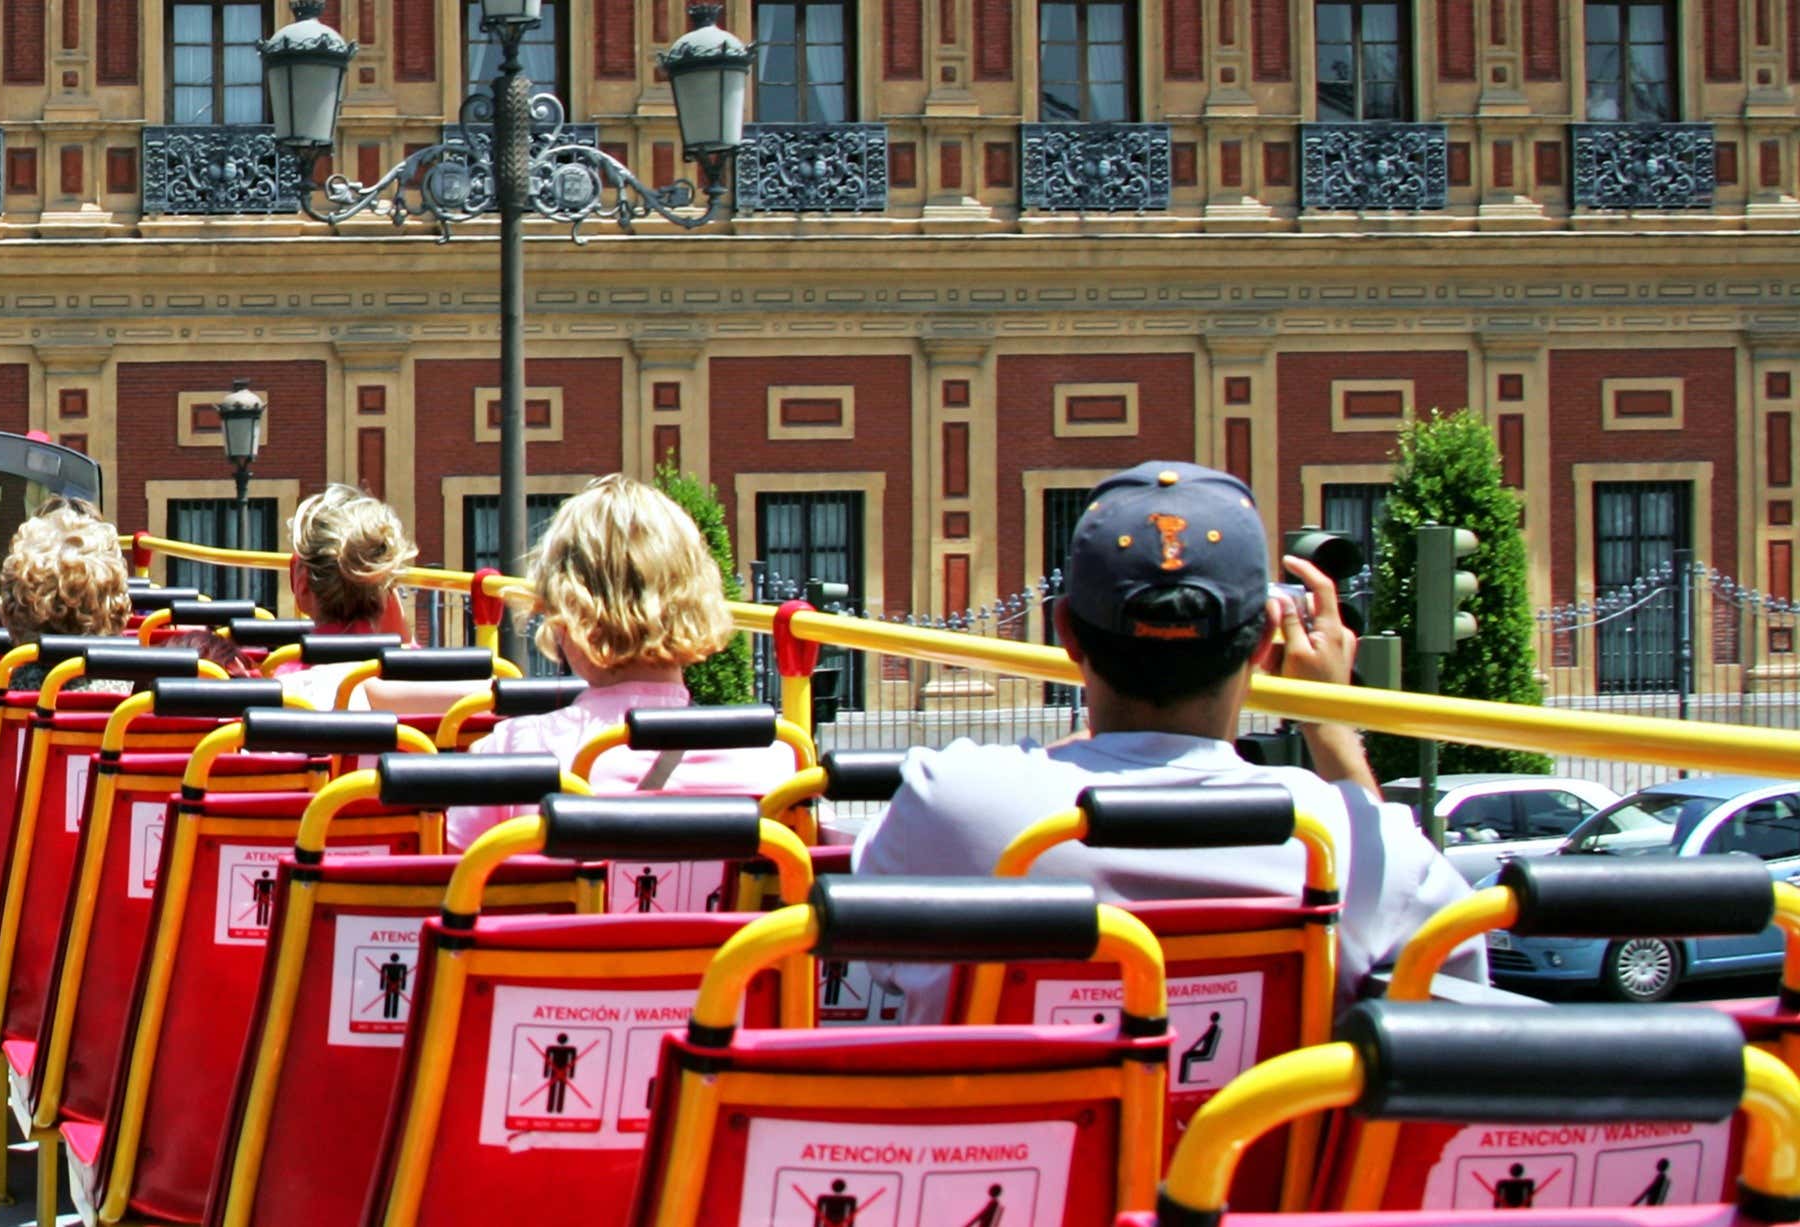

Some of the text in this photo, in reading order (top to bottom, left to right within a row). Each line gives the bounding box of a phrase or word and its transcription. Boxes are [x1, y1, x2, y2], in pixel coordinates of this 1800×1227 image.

[370, 930, 417, 942] ATENC
[1069, 980, 1238, 1001] ATENC WARNING
[533, 1005, 620, 1022] ATENCIÓN
[634, 1007, 695, 1021] WARNI
[1480, 1125, 1586, 1148] ATENCIÓN
[801, 1143, 913, 1163] ATENCIÓN
[932, 1143, 1029, 1163] WARNING
